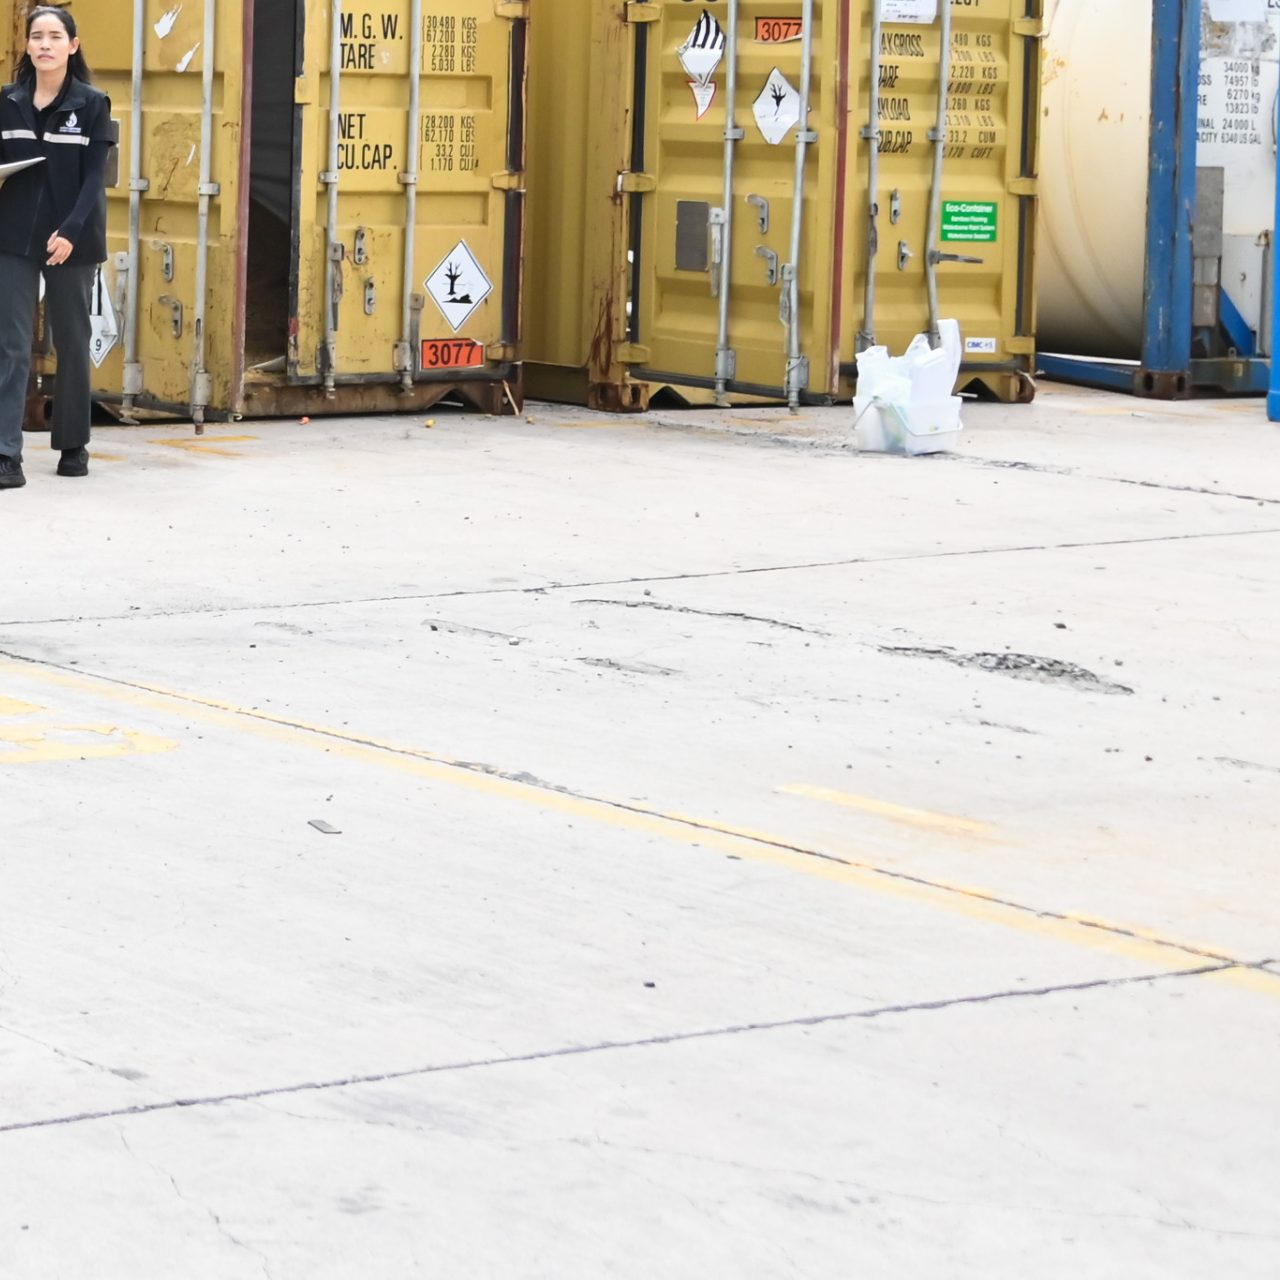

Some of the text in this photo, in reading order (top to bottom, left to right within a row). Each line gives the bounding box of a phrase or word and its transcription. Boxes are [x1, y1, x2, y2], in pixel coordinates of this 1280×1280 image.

[461, 17, 478, 30] KGS
[461, 30, 478, 44] LBS
[761, 21, 802, 41] 3077
[879, 32, 992, 57] AXGROSS KGS
[340, 43, 376, 70] TARE
[878, 64, 998, 88] TARE KGS
[977, 83, 996, 95] LBS
[1226, 89, 1250, 101] 6270
[975, 99, 991, 112] KGS
[1225, 103, 1250, 114] 13823
[337, 113, 366, 140] NET
[1251, 119, 1256, 131] L
[978, 130, 996, 143] CUM
[336, 143, 397, 170] CU.CAP.
[971, 147, 993, 159] CUFT
[95, 338, 102, 352] 9
[428, 341, 475, 366] 3077
